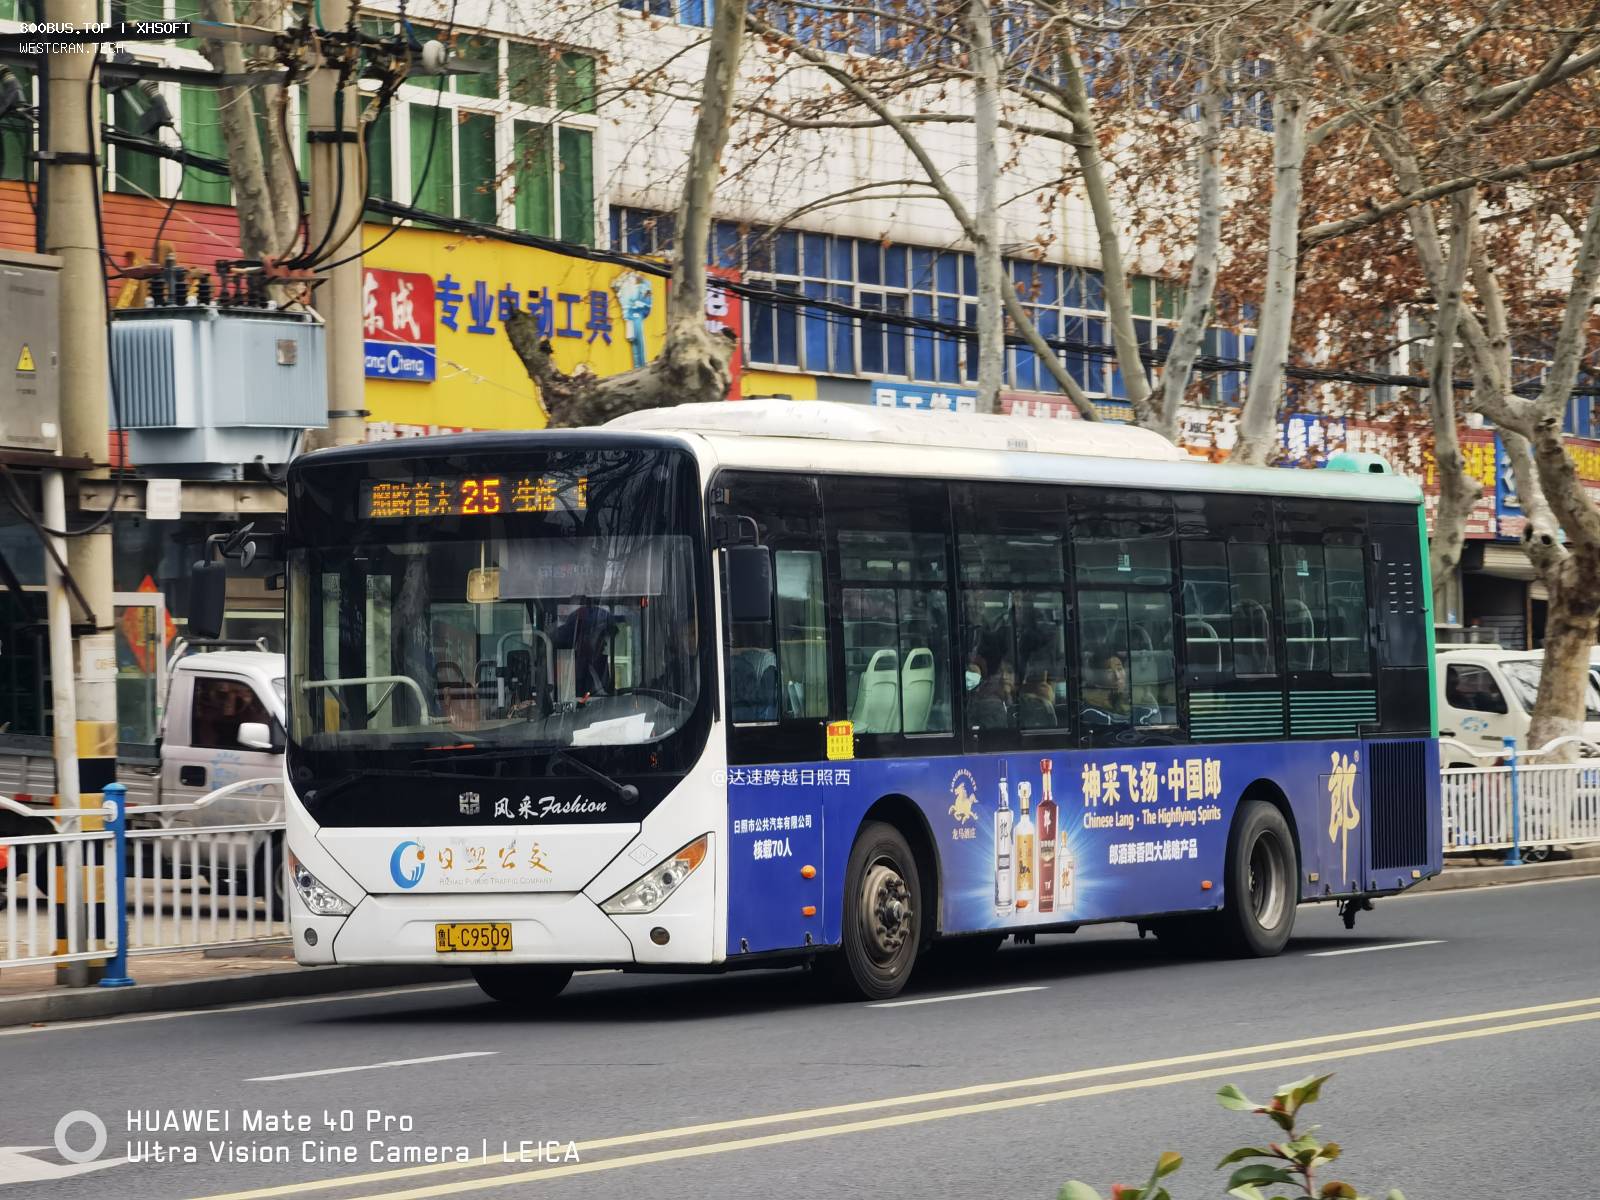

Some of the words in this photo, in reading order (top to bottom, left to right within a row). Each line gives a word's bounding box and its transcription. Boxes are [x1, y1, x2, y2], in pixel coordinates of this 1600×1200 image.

[435, 273, 612, 346] 专业电动工具
[462, 478, 500, 514] 25
[1081, 757, 1222, 807] 神采飞扬·中国郎
[734, 814, 812, 834] 日照市公共汽车有限公司
[1083, 812, 1114, 829] Chinese
[1115, 811, 1134, 831] Lang
[1142, 809, 1157, 825] The
[1158, 806, 1197, 828] Highflying
[1197, 804, 1222, 825] Spirits
[753, 837, 793, 860] 核载70人
